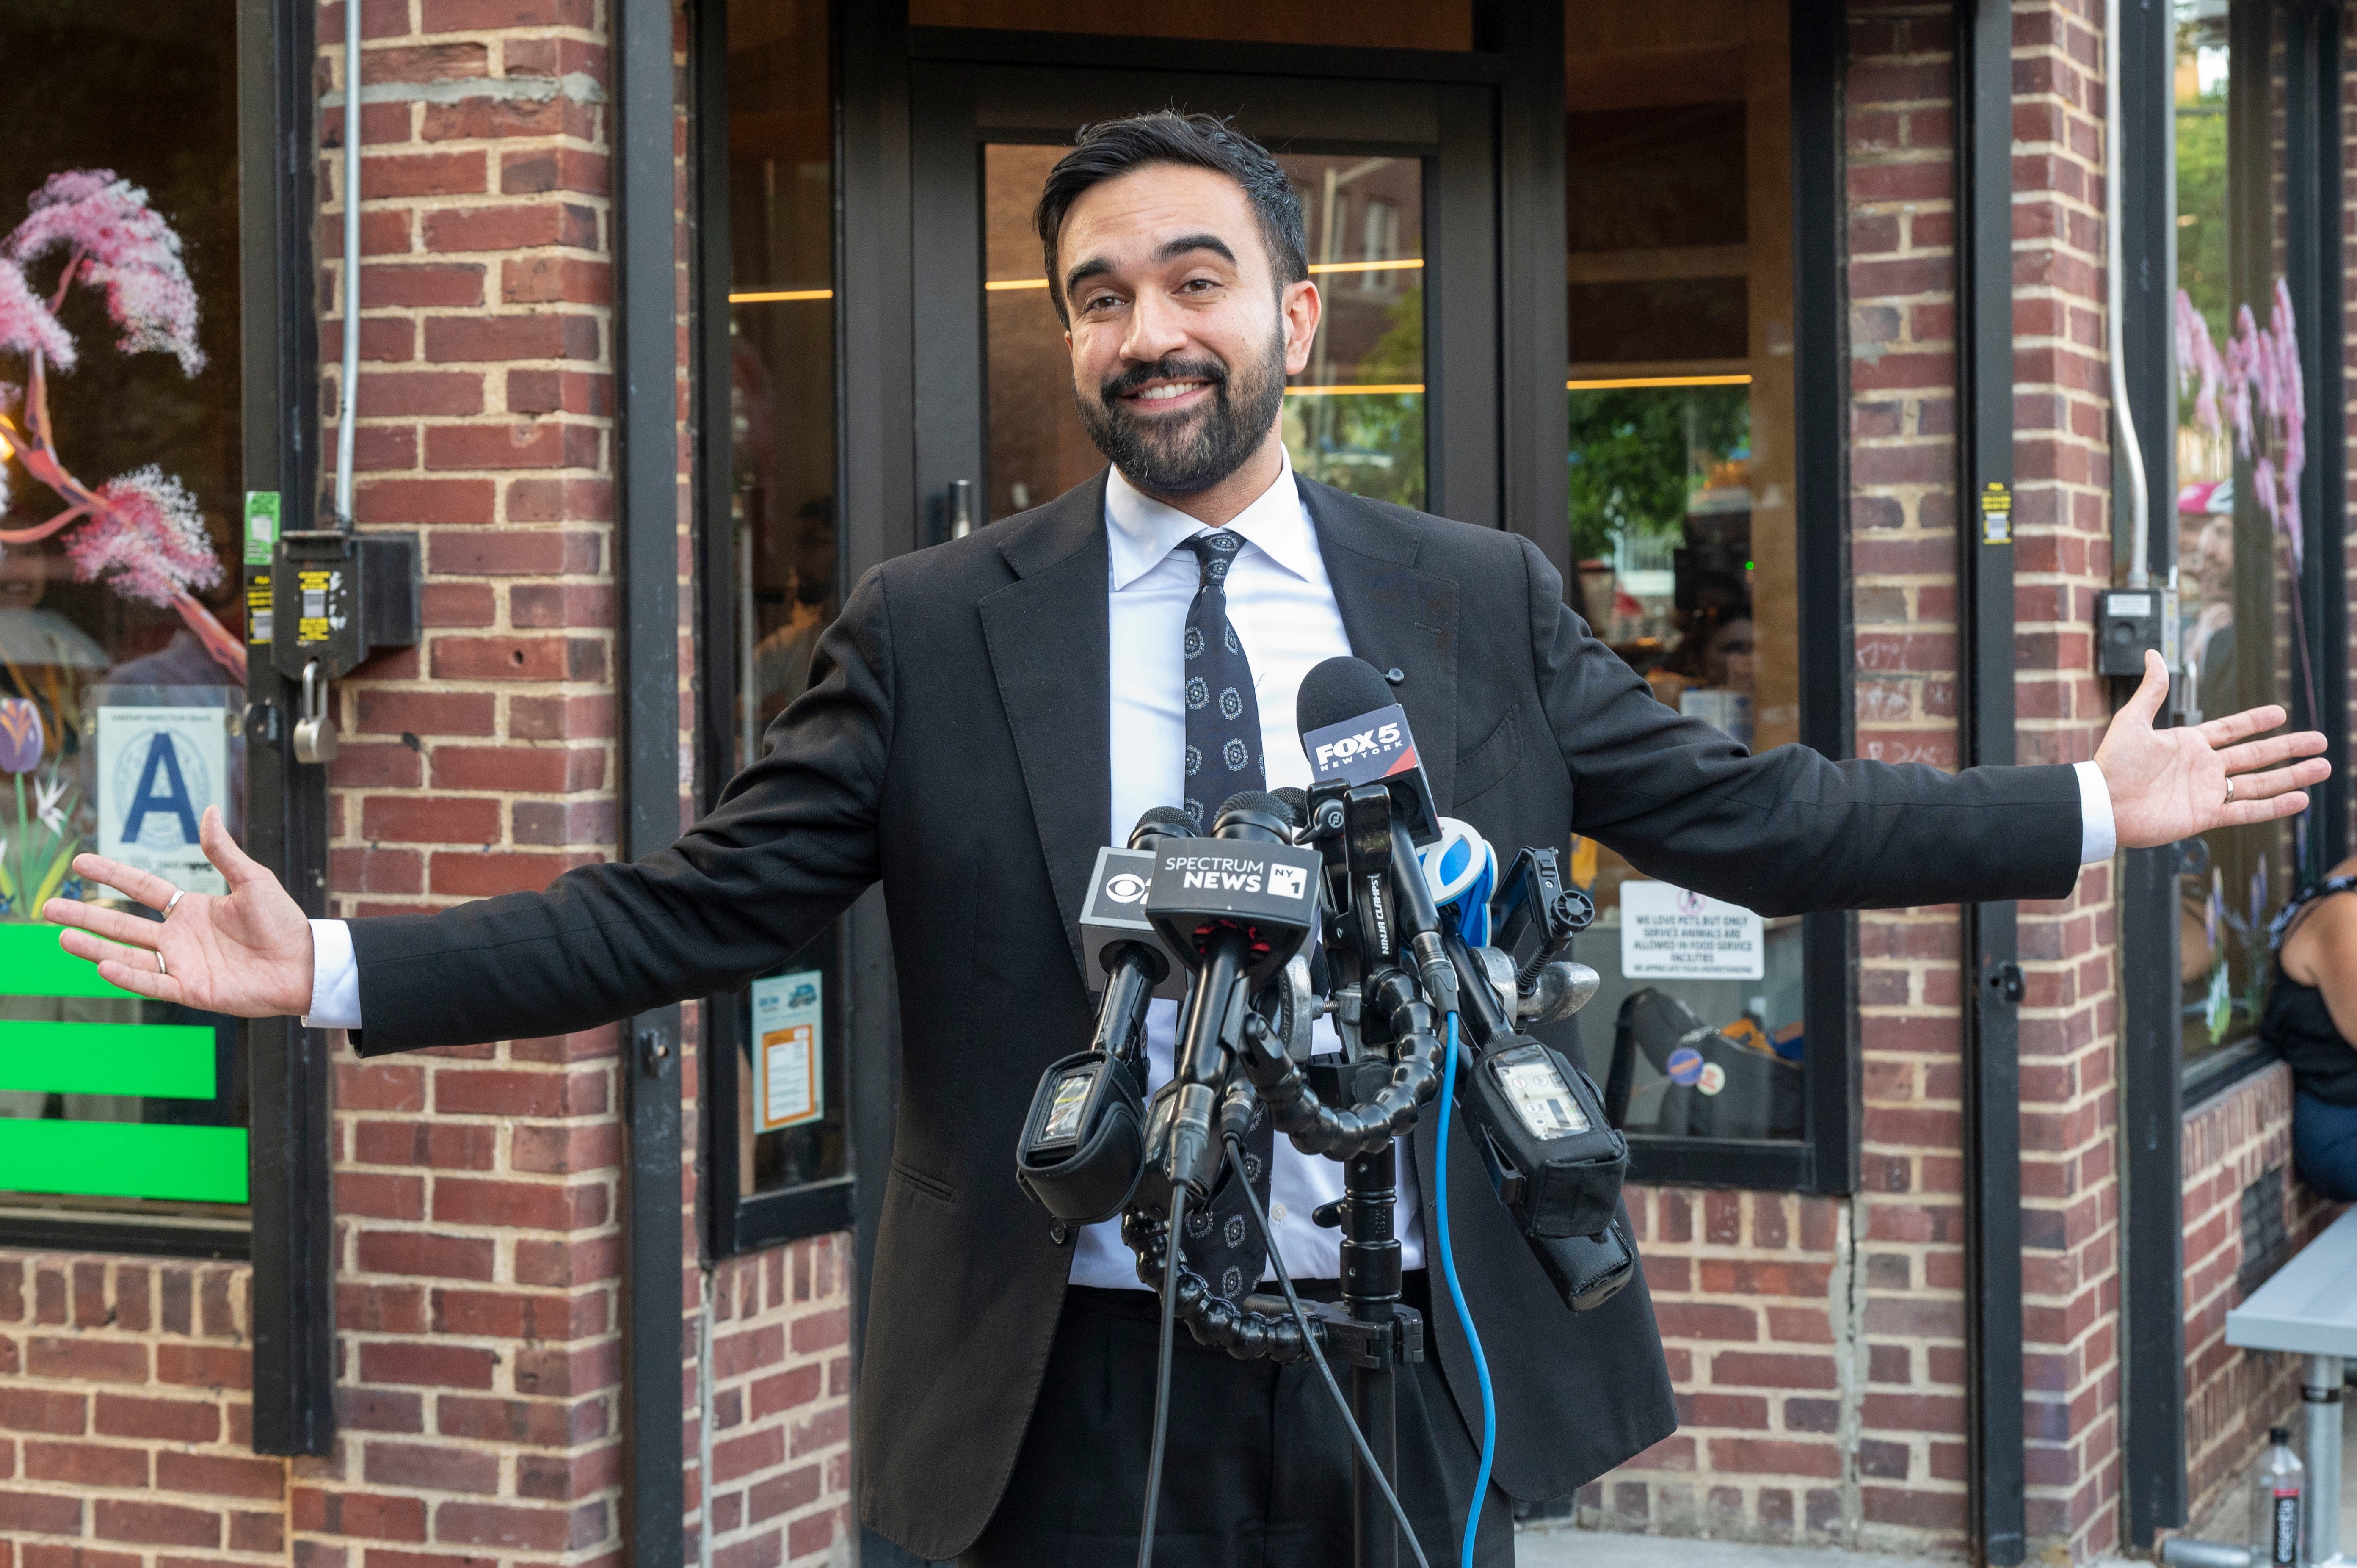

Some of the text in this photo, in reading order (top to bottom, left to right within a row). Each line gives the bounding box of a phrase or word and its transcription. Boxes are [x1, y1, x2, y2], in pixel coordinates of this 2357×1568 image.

[1316, 722, 1400, 765] FOX 5
[1320, 740, 1403, 772] NEW YORK
[120, 733, 201, 844] A
[1165, 857, 1264, 875] SPECTRUM
[1275, 868, 1294, 878] NY
[1183, 871, 1261, 893] NEWS
[1291, 882, 1300, 894] 1
[1372, 879, 1389, 955] NINJA CLAMPS
[1652, 915, 1675, 925] LOVE
[1702, 915, 1720, 925] BUT
[1723, 916, 1748, 925] ONLY
[1644, 928, 1678, 937] SERVICE
[1681, 928, 1721, 937] ANIMALS
[1634, 940, 1674, 950] ALLOWED
[1717, 940, 1752, 950] SERVICE
